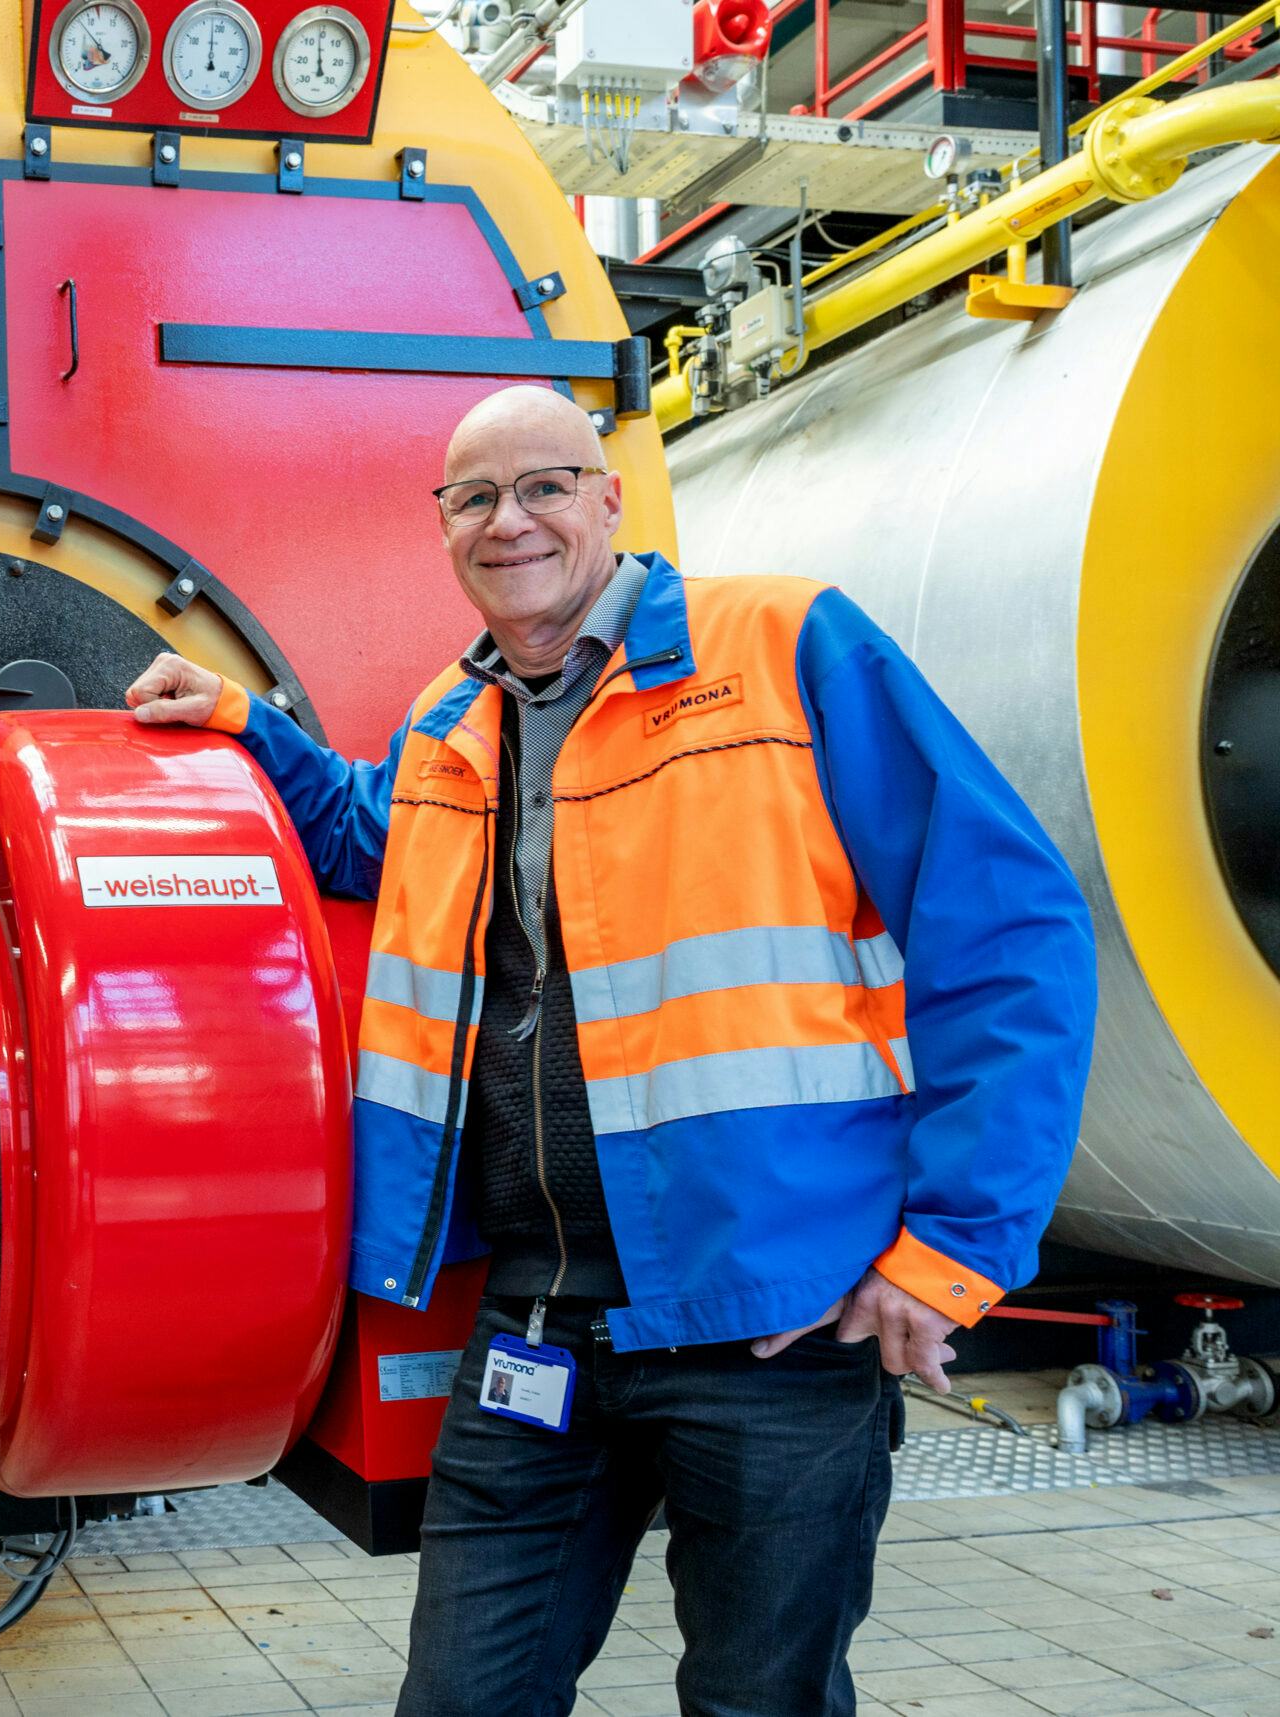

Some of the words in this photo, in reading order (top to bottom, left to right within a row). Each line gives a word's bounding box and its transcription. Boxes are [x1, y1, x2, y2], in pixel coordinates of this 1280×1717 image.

[189, 37, 199, 45] 100
[330, 40, 341, 48] 10
[332, 58, 344, 66] 20
[323, 76, 335, 85] 30
[652, 685, 732, 726] VRUMONA
[493, 1357, 536, 1376] vrumona
